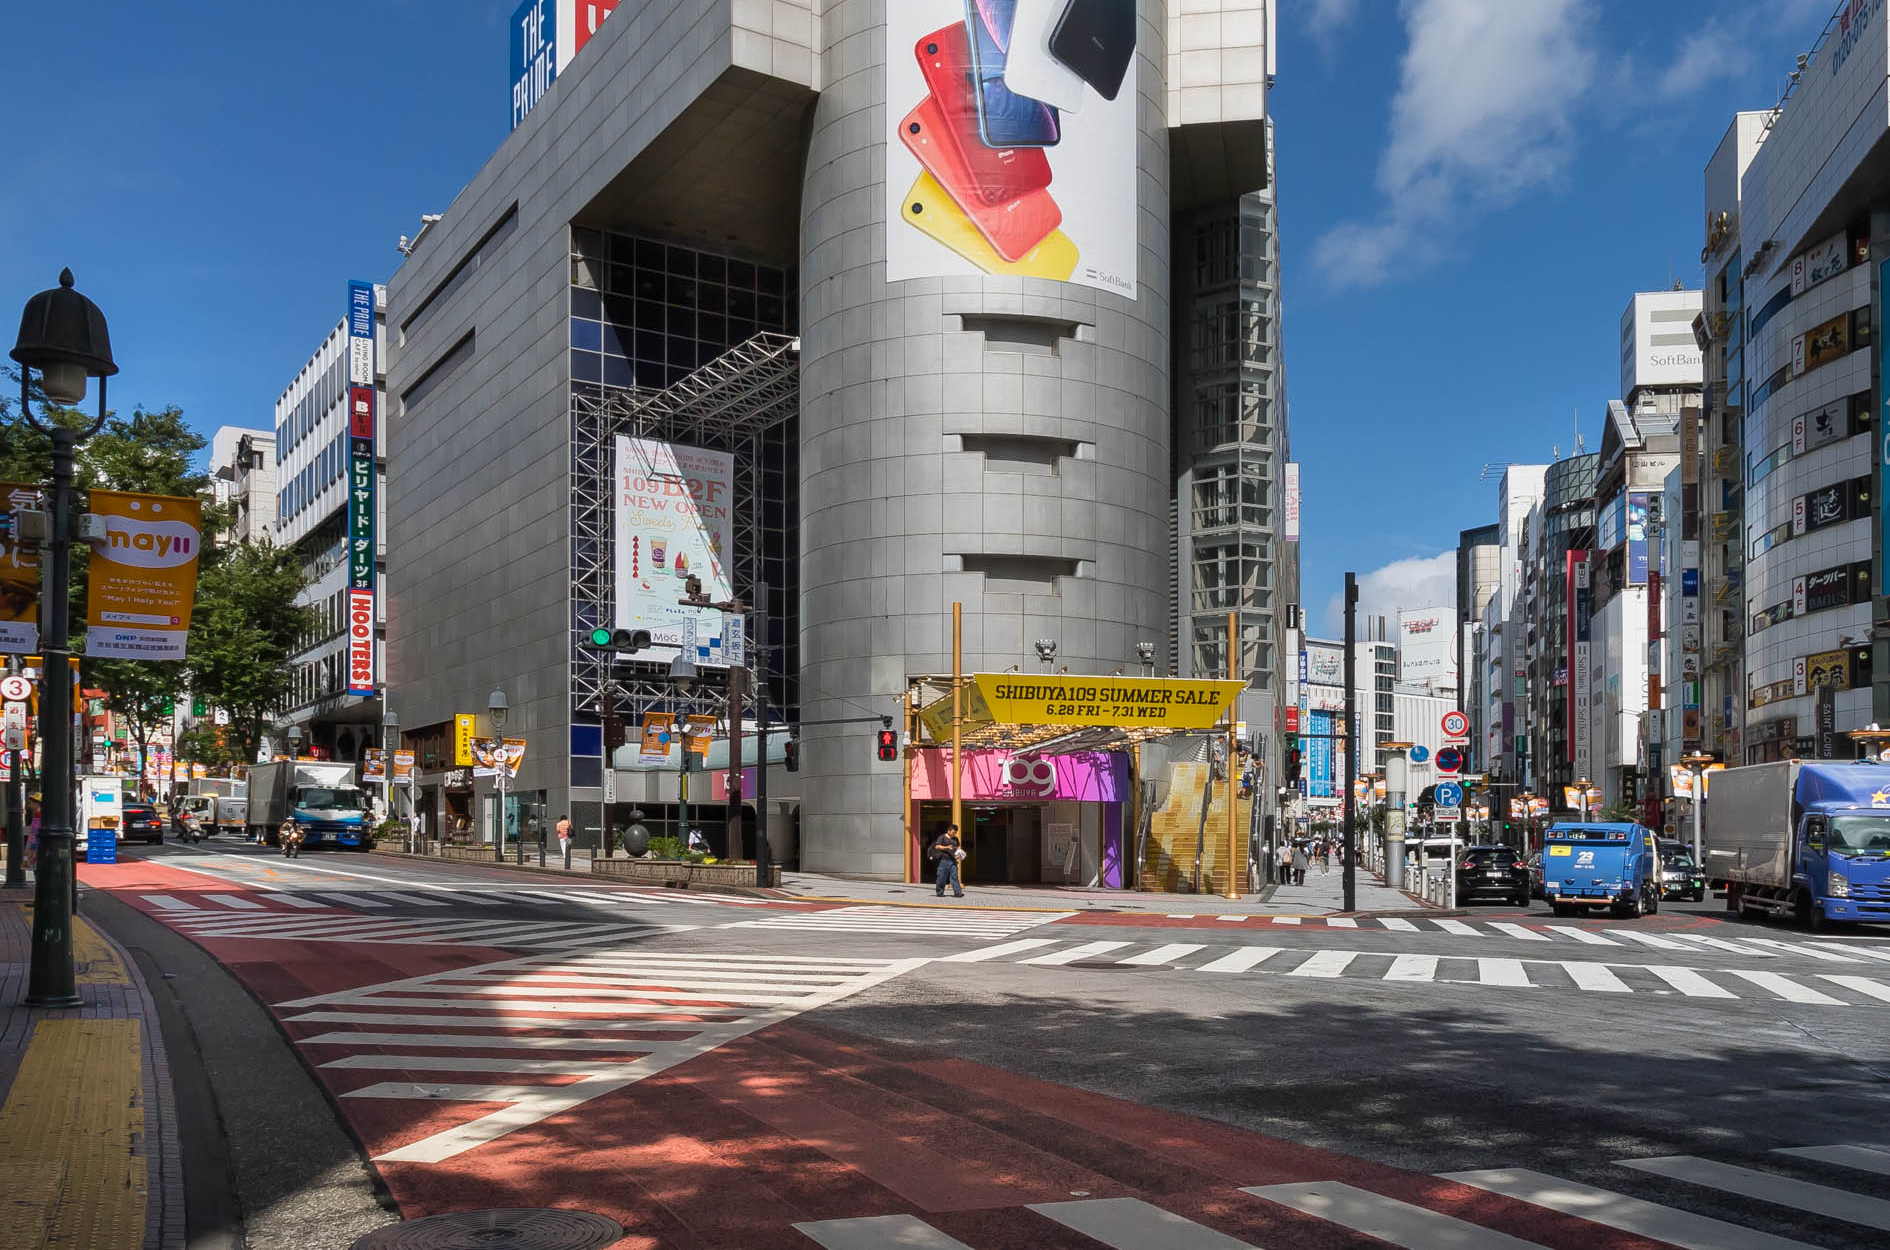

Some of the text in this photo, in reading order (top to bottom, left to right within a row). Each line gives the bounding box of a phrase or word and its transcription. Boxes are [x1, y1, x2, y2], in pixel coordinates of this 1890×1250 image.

[1099, 271, 1133, 291] SoftBank
[1794, 261, 1803, 290] 8F
[354, 289, 369, 336] THE PRIME
[1650, 354, 1703, 366] SoftBan
[1794, 341, 1803, 368] 7F
[1794, 421, 1803, 450] 6F
[623, 475, 660, 493] 109
[623, 494, 726, 519] NEW OPEN
[1795, 502, 1803, 528] 5F
[356, 579, 368, 588] 3F
[1795, 581, 1804, 609] 4F
[352, 598, 371, 681] HOOTERS
[9, 680, 24, 695] 3
[1795, 662, 1804, 689] 3F
[995, 684, 1221, 706] SHIBUYA109 SUMMER SALE
[1046, 704, 1075, 716] 6.28
[1076, 705, 1101, 717] FRI
[1112, 706, 1135, 717] 7.31
[1136, 707, 1167, 718] WED
[1447, 718, 1463, 730] 30
[1823, 703, 1832, 758] SAINT LOUIS
[496, 750, 504, 760] 4
[998, 756, 1056, 797] 109
[1001, 788, 1036, 798] SHIBUYA
